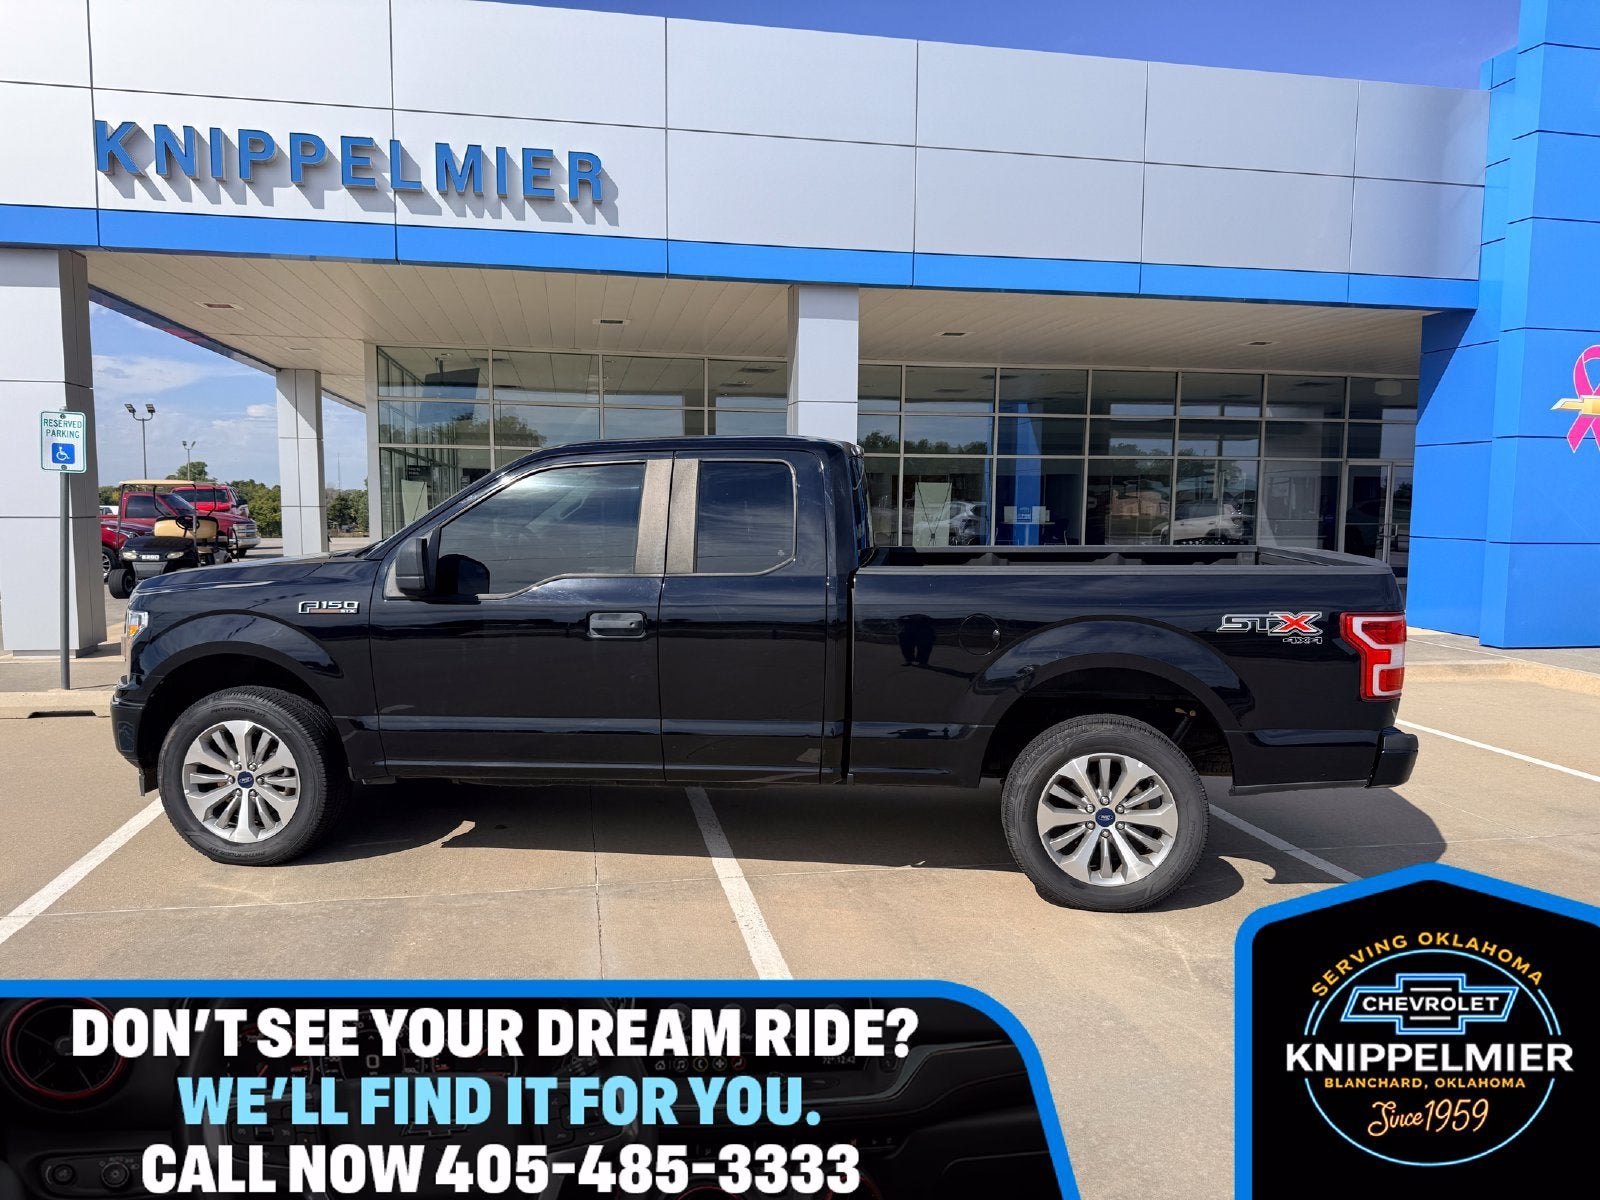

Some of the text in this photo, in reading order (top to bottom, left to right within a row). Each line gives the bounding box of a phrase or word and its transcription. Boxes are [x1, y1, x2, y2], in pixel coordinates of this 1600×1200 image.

[94, 119, 604, 204] KNIPPELMIER
[43, 418, 82, 428] RESERVED
[45, 429, 80, 438] PARKING
[1216, 611, 1323, 636] STX
